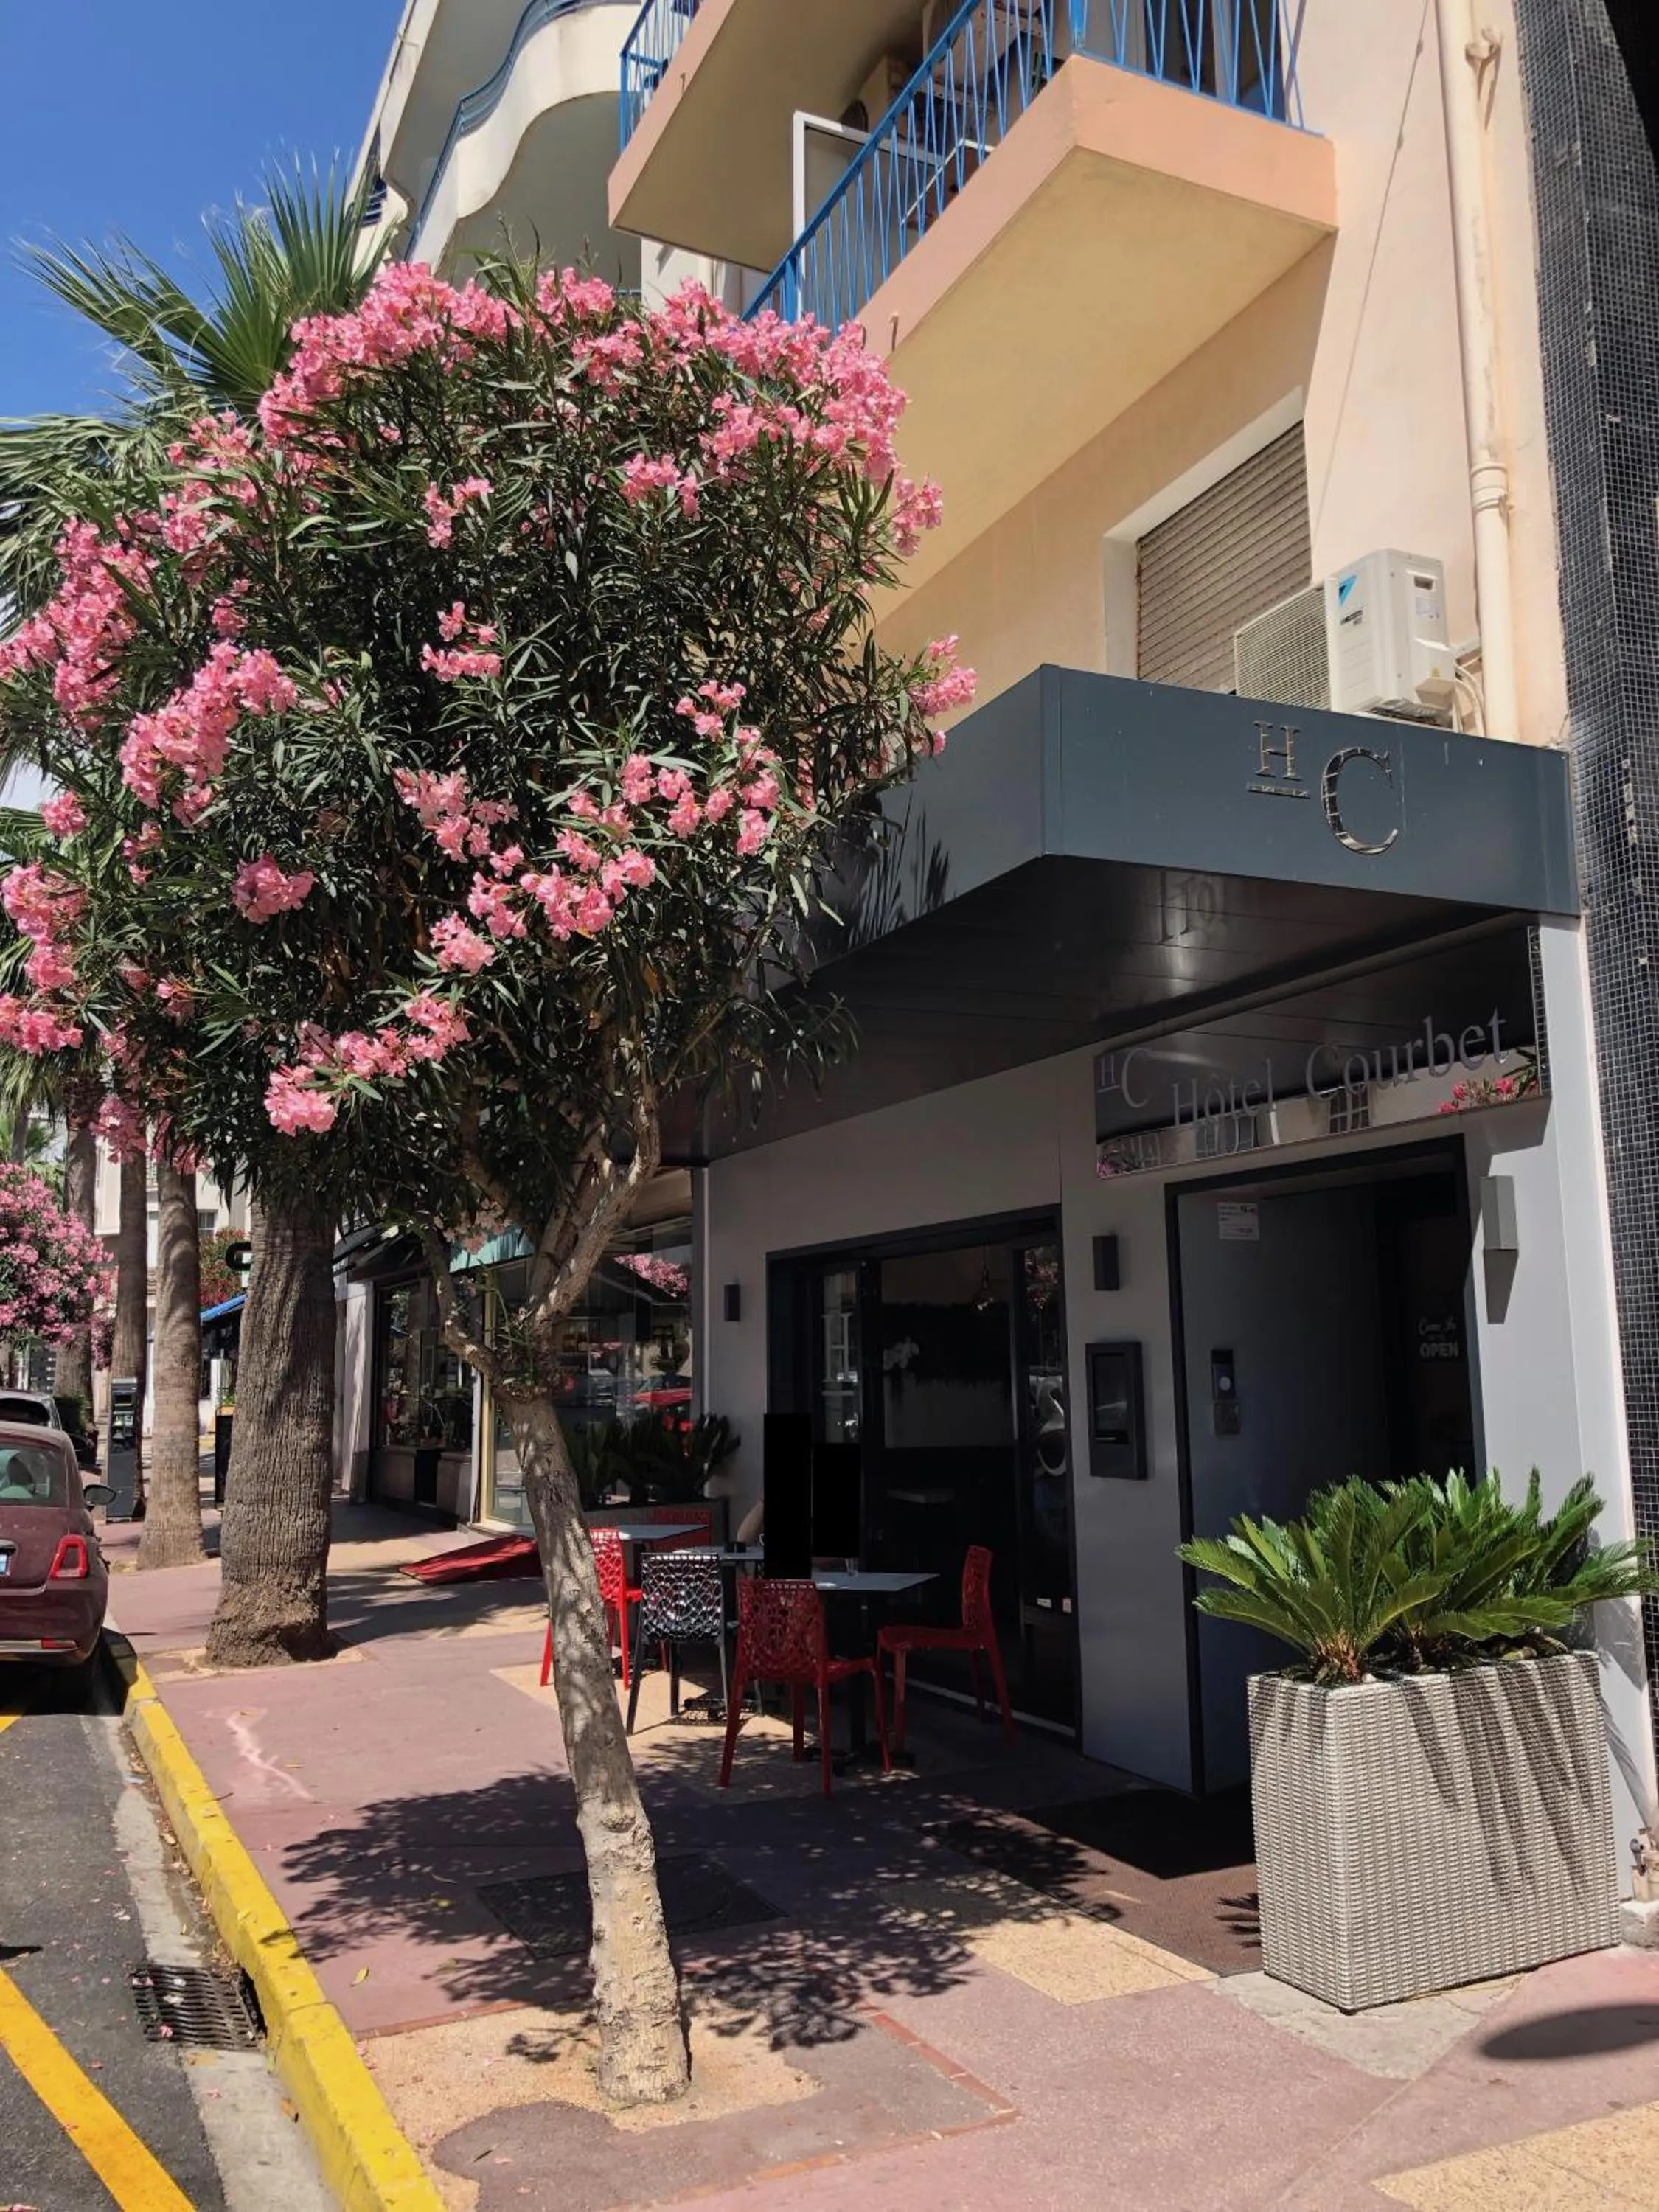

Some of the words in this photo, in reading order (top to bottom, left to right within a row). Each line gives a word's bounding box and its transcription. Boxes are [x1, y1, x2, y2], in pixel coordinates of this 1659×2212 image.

[1172, 1056, 1277, 1127] Hôtel
[1305, 1006, 1511, 1100] Courbet
[1419, 1343, 1458, 1357] OPEN
